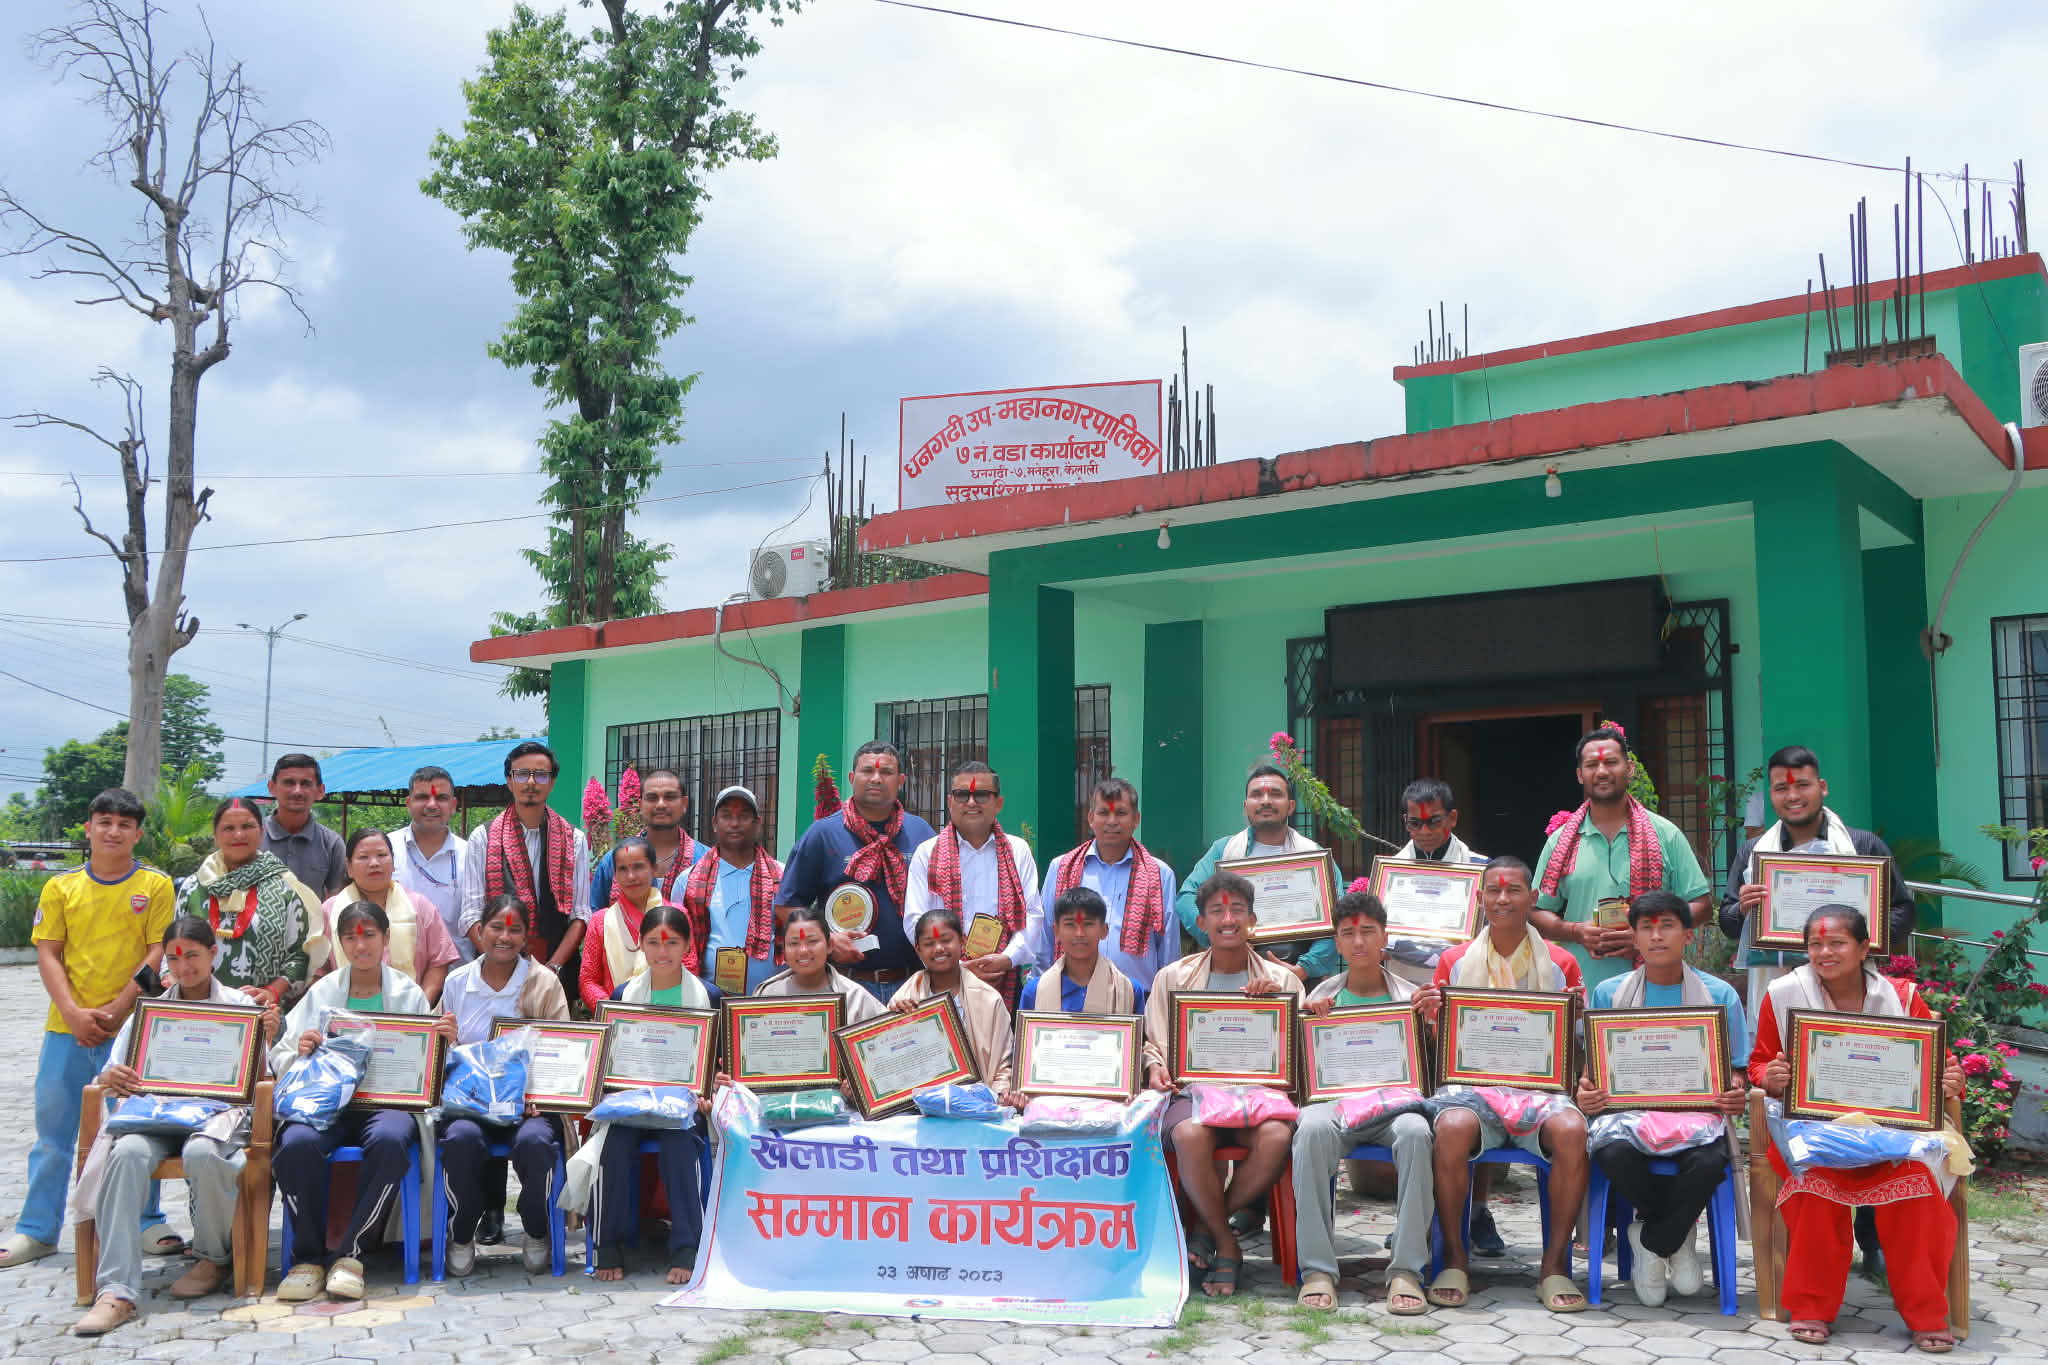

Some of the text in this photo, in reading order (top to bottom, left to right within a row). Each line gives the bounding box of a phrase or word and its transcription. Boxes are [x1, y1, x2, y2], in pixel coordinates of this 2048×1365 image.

[904, 414, 967, 479] धनगढी
[956, 446, 970, 464] ७
[1030, 435, 1107, 461] कार्यालय
[750, 1128, 1132, 1181] खेलाडी तथा प्रशिक्षक
[746, 1188, 1137, 1250] सम्मान कार्यक्रम
[877, 1265, 897, 1280] २३
[958, 1268, 1003, 1283] २०८३
